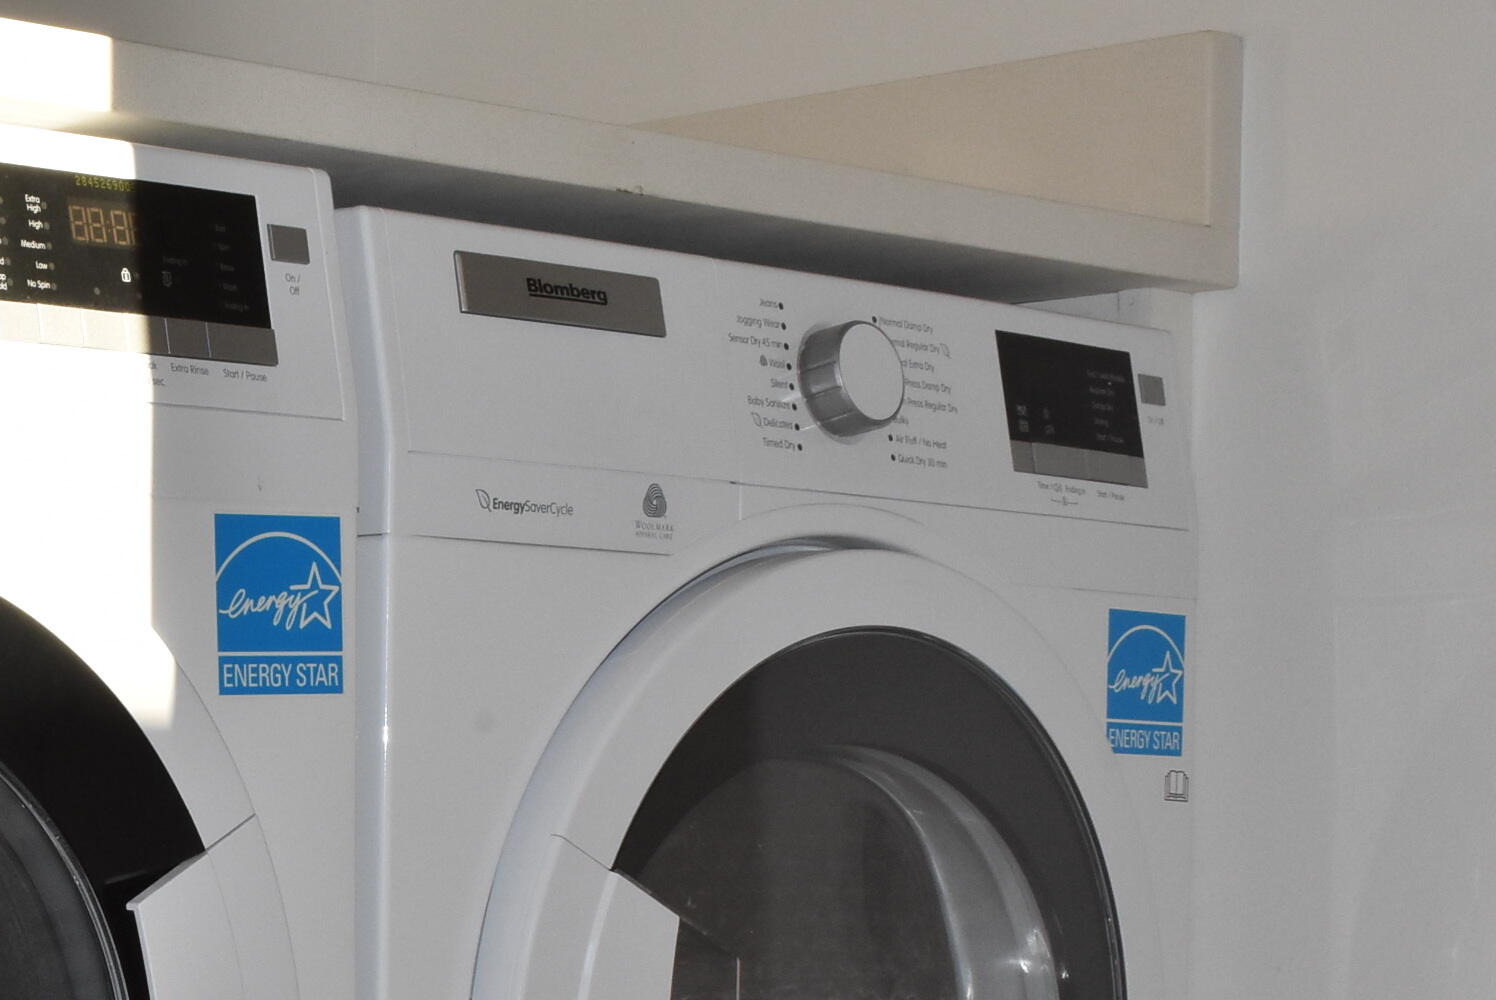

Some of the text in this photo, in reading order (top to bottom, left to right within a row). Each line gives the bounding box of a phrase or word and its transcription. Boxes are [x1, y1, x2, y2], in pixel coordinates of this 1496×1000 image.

[25, 194, 40, 204] Extra
[26, 203, 42, 214] High
[28, 219, 44, 230] High
[20, 239, 46, 250] Medium
[35, 260, 48, 270] Low
[26, 279, 51, 290] No Spin
[526, 277, 608, 306] Blomberg
[170, 363, 189, 374] Extra
[190, 364, 209, 376] Rinse
[223, 368, 240, 379] Start
[246, 371, 268, 382] Pause
[492, 497, 574, 517] EnergySaverCycle
[218, 588, 311, 631] energy
[223, 663, 339, 688] ENERGY STAR
[1108, 669, 1163, 704] energy
[1109, 728, 1181, 751] ENERGY STAR
